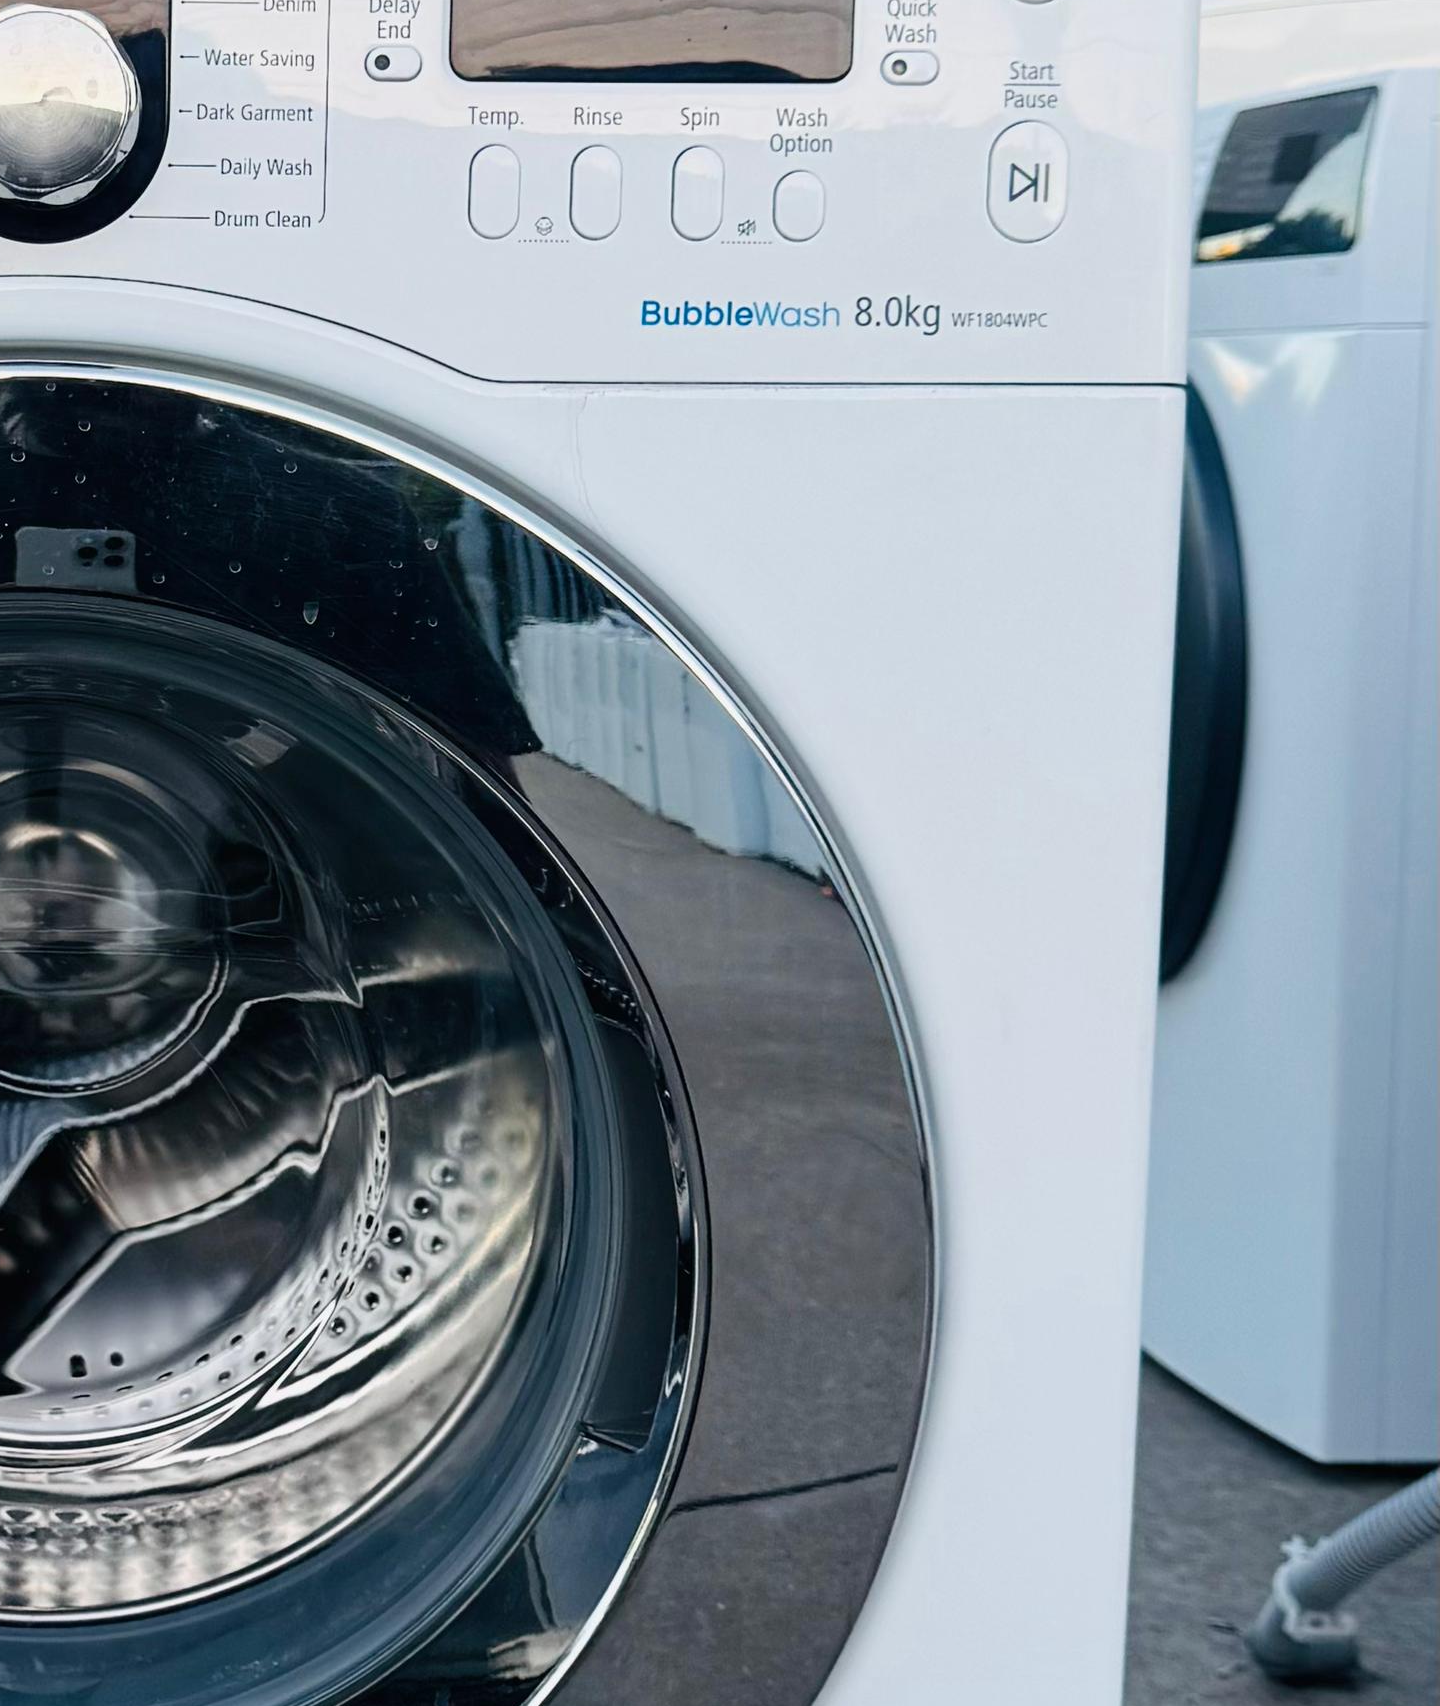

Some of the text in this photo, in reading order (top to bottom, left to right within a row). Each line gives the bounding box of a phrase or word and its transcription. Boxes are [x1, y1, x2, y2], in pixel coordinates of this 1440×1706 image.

[377, 21, 411, 40] End
[884, 23, 937, 44] Wash
[204, 48, 315, 72] Water Saving
[1009, 60, 1055, 81] Start
[1004, 89, 1058, 109] Pause
[196, 102, 313, 122] Dark Garment
[467, 105, 524, 131] Temp.
[573, 106, 623, 126] Rinse
[680, 106, 720, 132] Spin
[776, 107, 828, 128] Wash
[769, 132, 833, 158] Option
[220, 157, 313, 180] Daily Wash
[214, 210, 311, 228] Drum Clean
[641, 300, 840, 327] BubbleWash
[854, 294, 941, 337] 8.0kg
